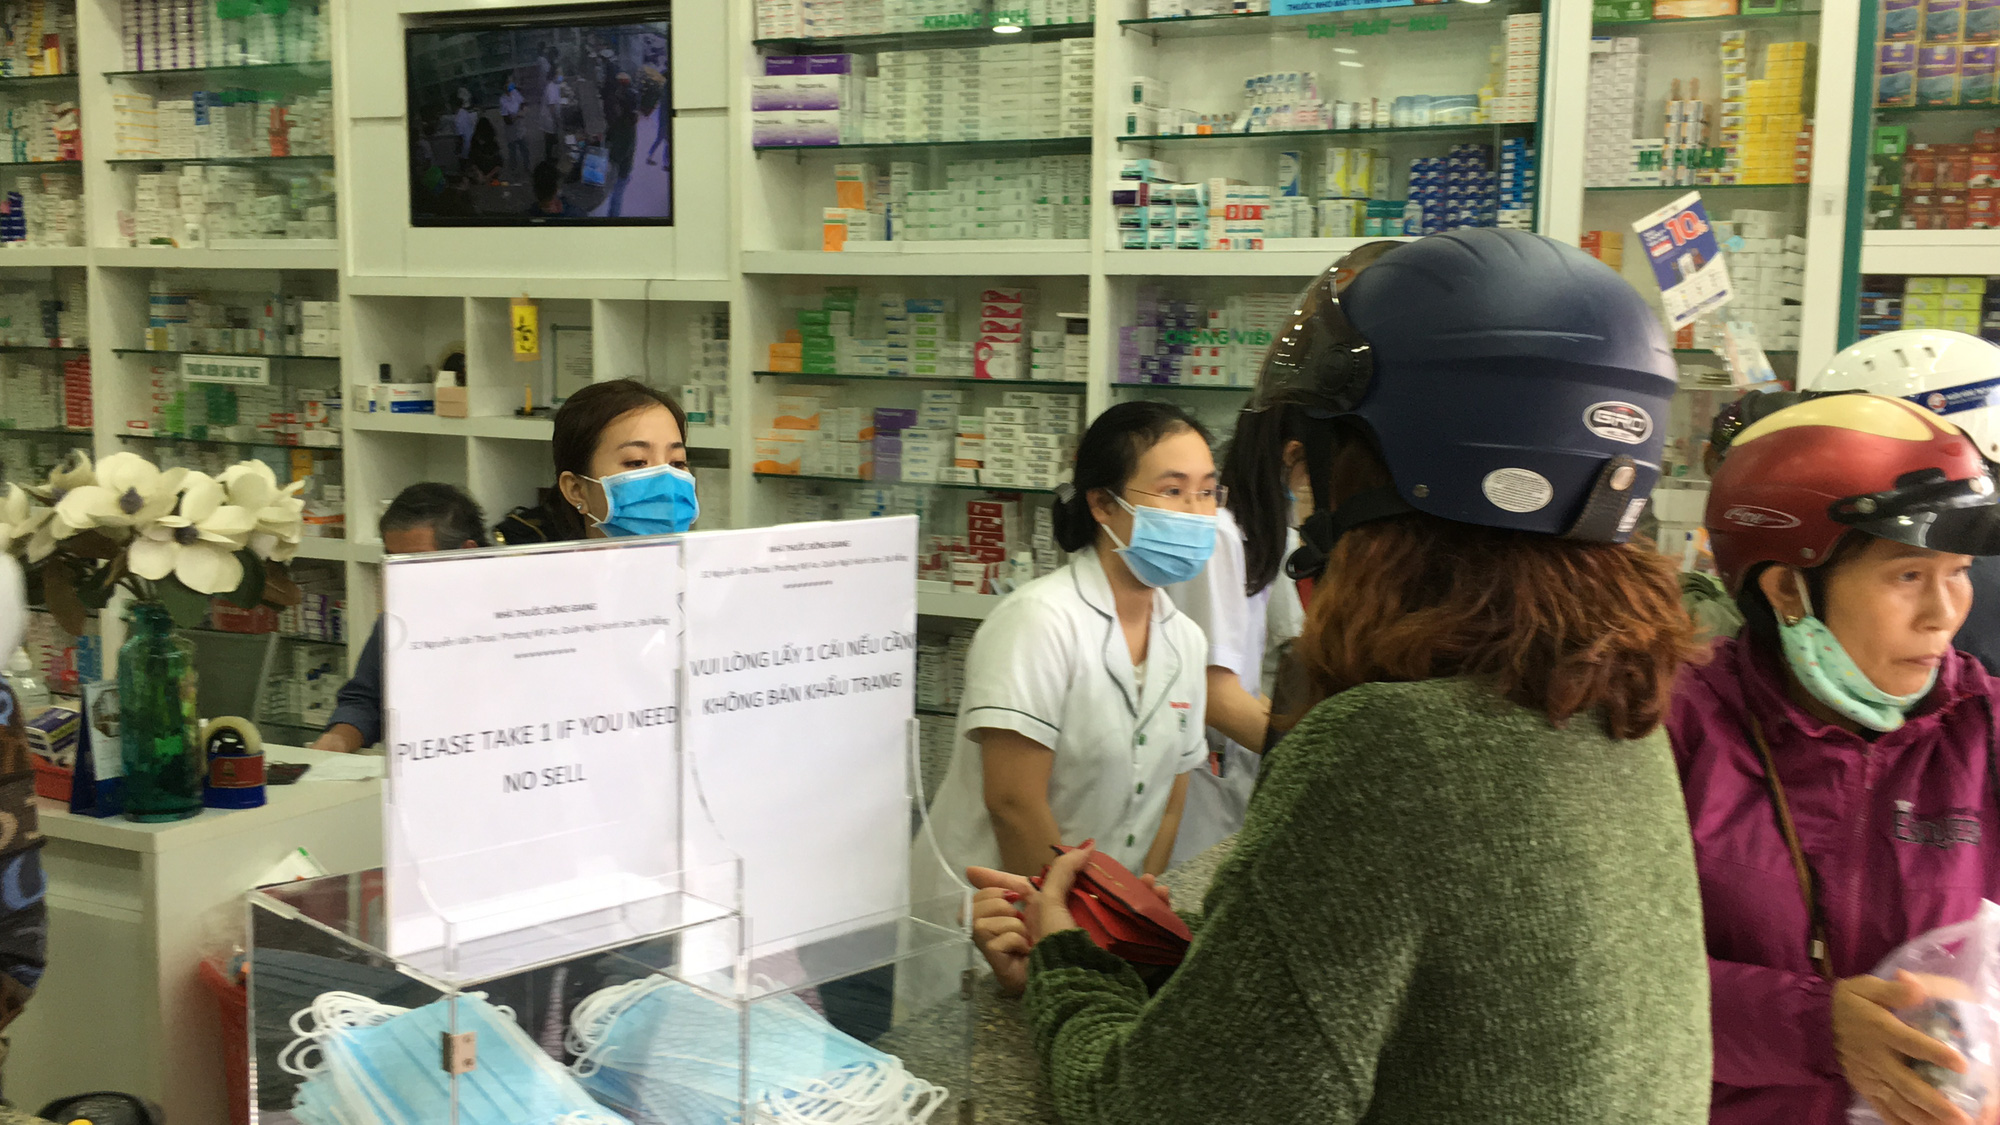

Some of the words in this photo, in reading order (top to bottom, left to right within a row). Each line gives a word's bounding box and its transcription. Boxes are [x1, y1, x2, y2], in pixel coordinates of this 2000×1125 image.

[689, 657, 720, 676] VUI
[722, 650, 769, 673] LÒNG
[772, 642, 803, 666] LẤY
[806, 646, 816, 662] 1
[818, 638, 844, 661] CÁI
[847, 633, 880, 656] NẾU
[702, 690, 764, 715] KHÔNG
[766, 683, 801, 706] BÁN
[850, 672, 903, 694] TRANG
[397, 733, 476, 762] PLEASE
[480, 724, 535, 751] TAKE
[539, 723, 553, 742] 1
[557, 720, 576, 740] IF
[579, 713, 624, 735] YOU
[627, 705, 680, 729] NEED
[502, 770, 538, 794] NO
[541, 764, 588, 788] SELL
